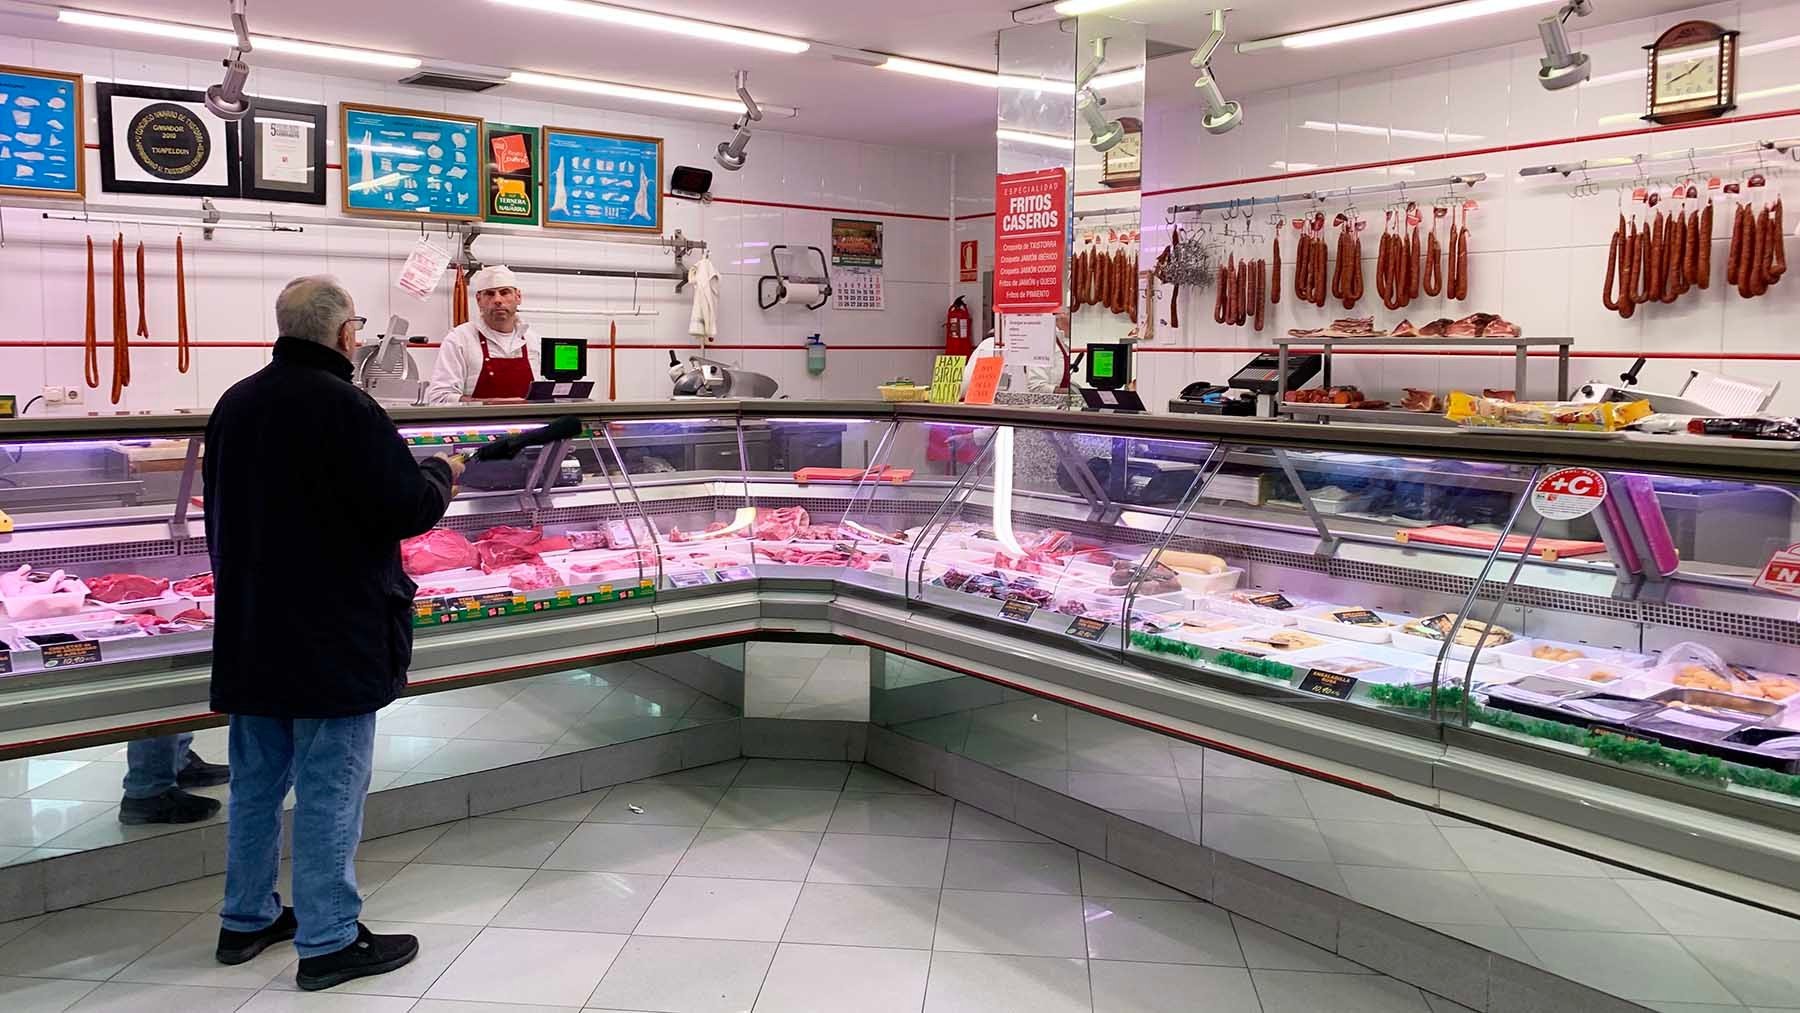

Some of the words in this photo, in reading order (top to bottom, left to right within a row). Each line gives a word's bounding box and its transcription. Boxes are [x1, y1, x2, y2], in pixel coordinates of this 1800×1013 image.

[152, 124, 184, 132] GANADOR
[151, 147, 190, 155] TXAPELDUN
[1003, 182, 1059, 196] ESPECIALIDAD
[499, 197, 527, 205] TERNERA
[1009, 193, 1052, 214] FRITOS
[498, 204, 527, 213] NAVARRA
[1002, 210, 1059, 232] CASEROS
[1030, 240, 1057, 249] TXISTORRA
[939, 356, 960, 367] HAY
[934, 366, 963, 383] BIRICA
[1313, 671, 1350, 683] ENSALADILLA
